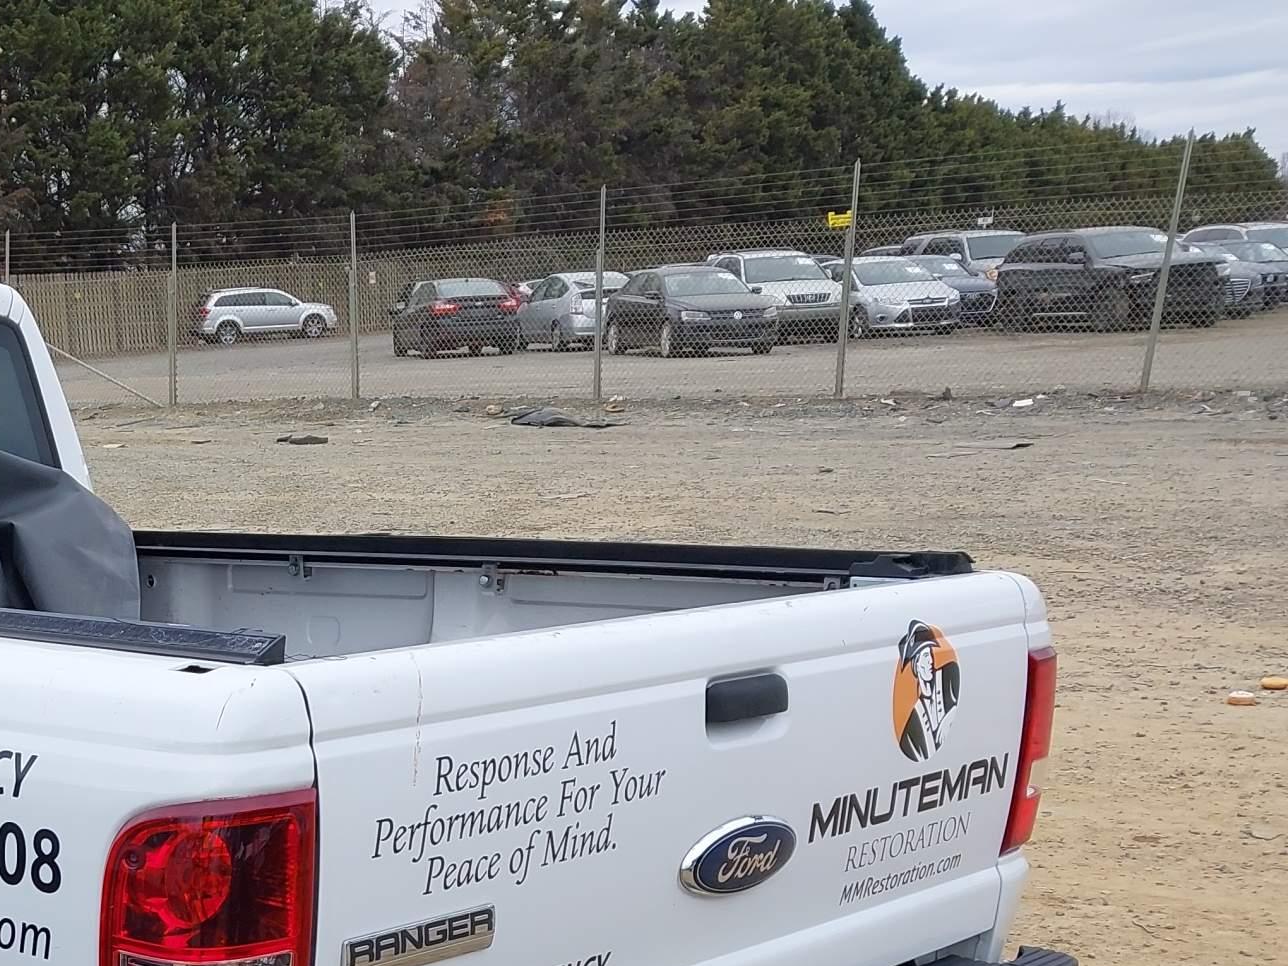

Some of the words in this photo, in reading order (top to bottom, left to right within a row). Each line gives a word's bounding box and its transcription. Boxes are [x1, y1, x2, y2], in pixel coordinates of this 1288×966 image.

[433, 743, 555, 799] Response
[561, 720, 618, 770] And
[808, 752, 1009, 843] MINUTEMAN
[371, 794, 549, 863] Performance
[557, 778, 601, 818] For
[610, 767, 667, 806] Your
[422, 853, 501, 895] Peace
[509, 829, 541, 885] of
[541, 814, 618, 867] Mind.
[844, 812, 971, 872] RESTORATION
[717, 833, 782, 884] Ford
[839, 852, 962, 906] MMRestoration.com
